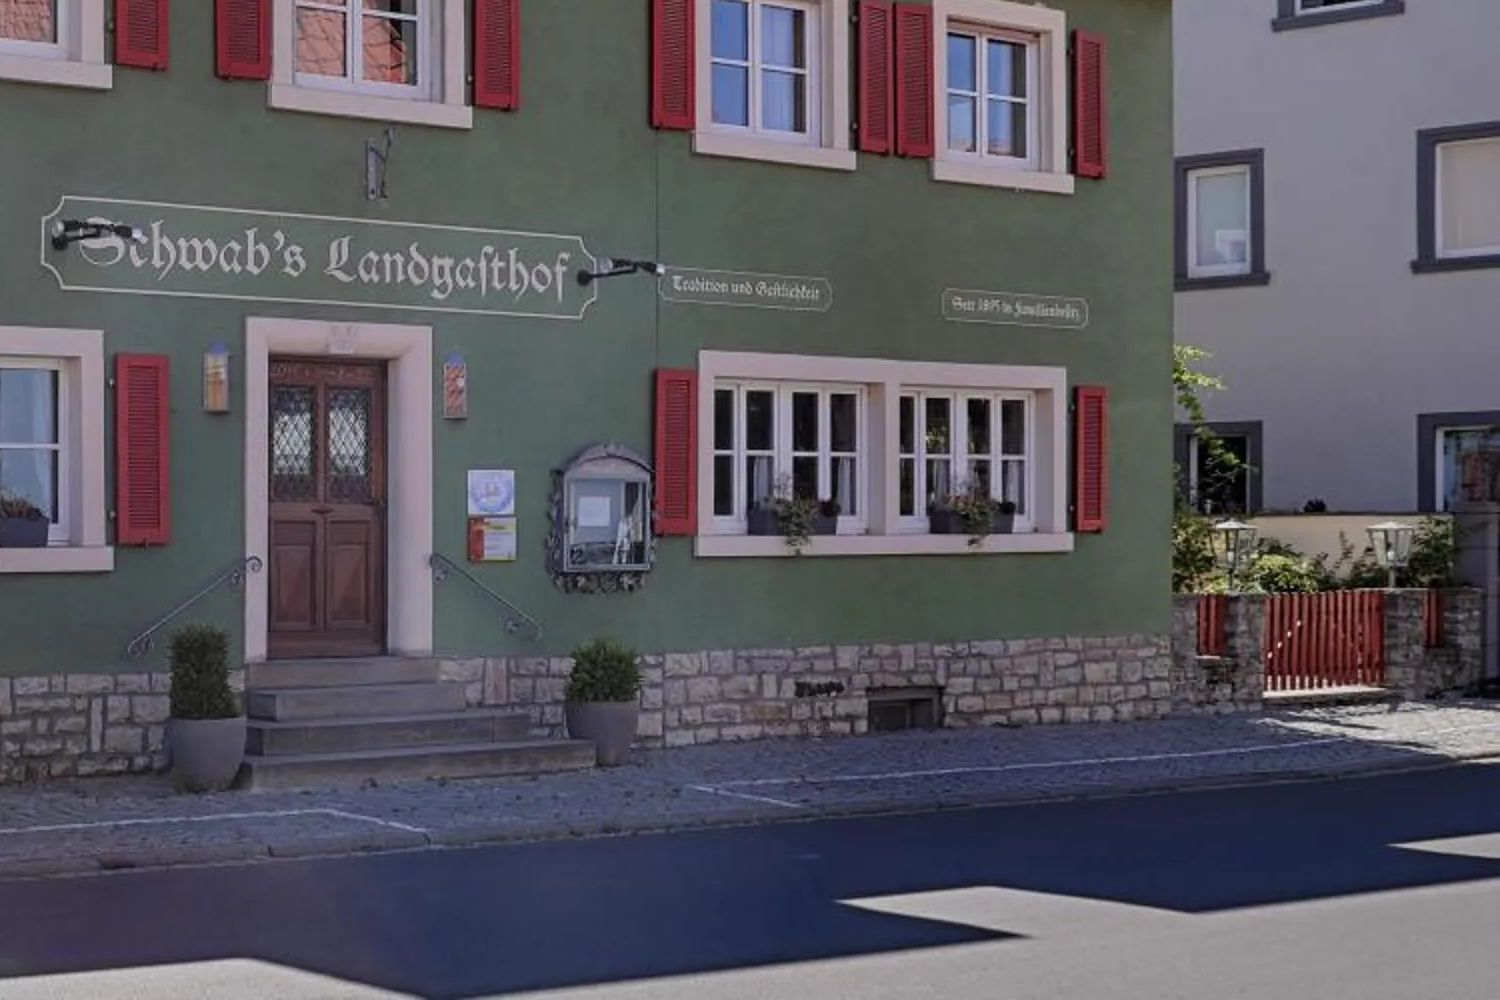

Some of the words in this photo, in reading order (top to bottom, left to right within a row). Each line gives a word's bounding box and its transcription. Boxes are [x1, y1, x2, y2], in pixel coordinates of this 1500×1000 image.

[79, 216, 307, 281] Schwab's
[324, 235, 569, 302] Landgasthof
[672, 275, 729, 294] Tradition
[731, 281, 753, 295] und
